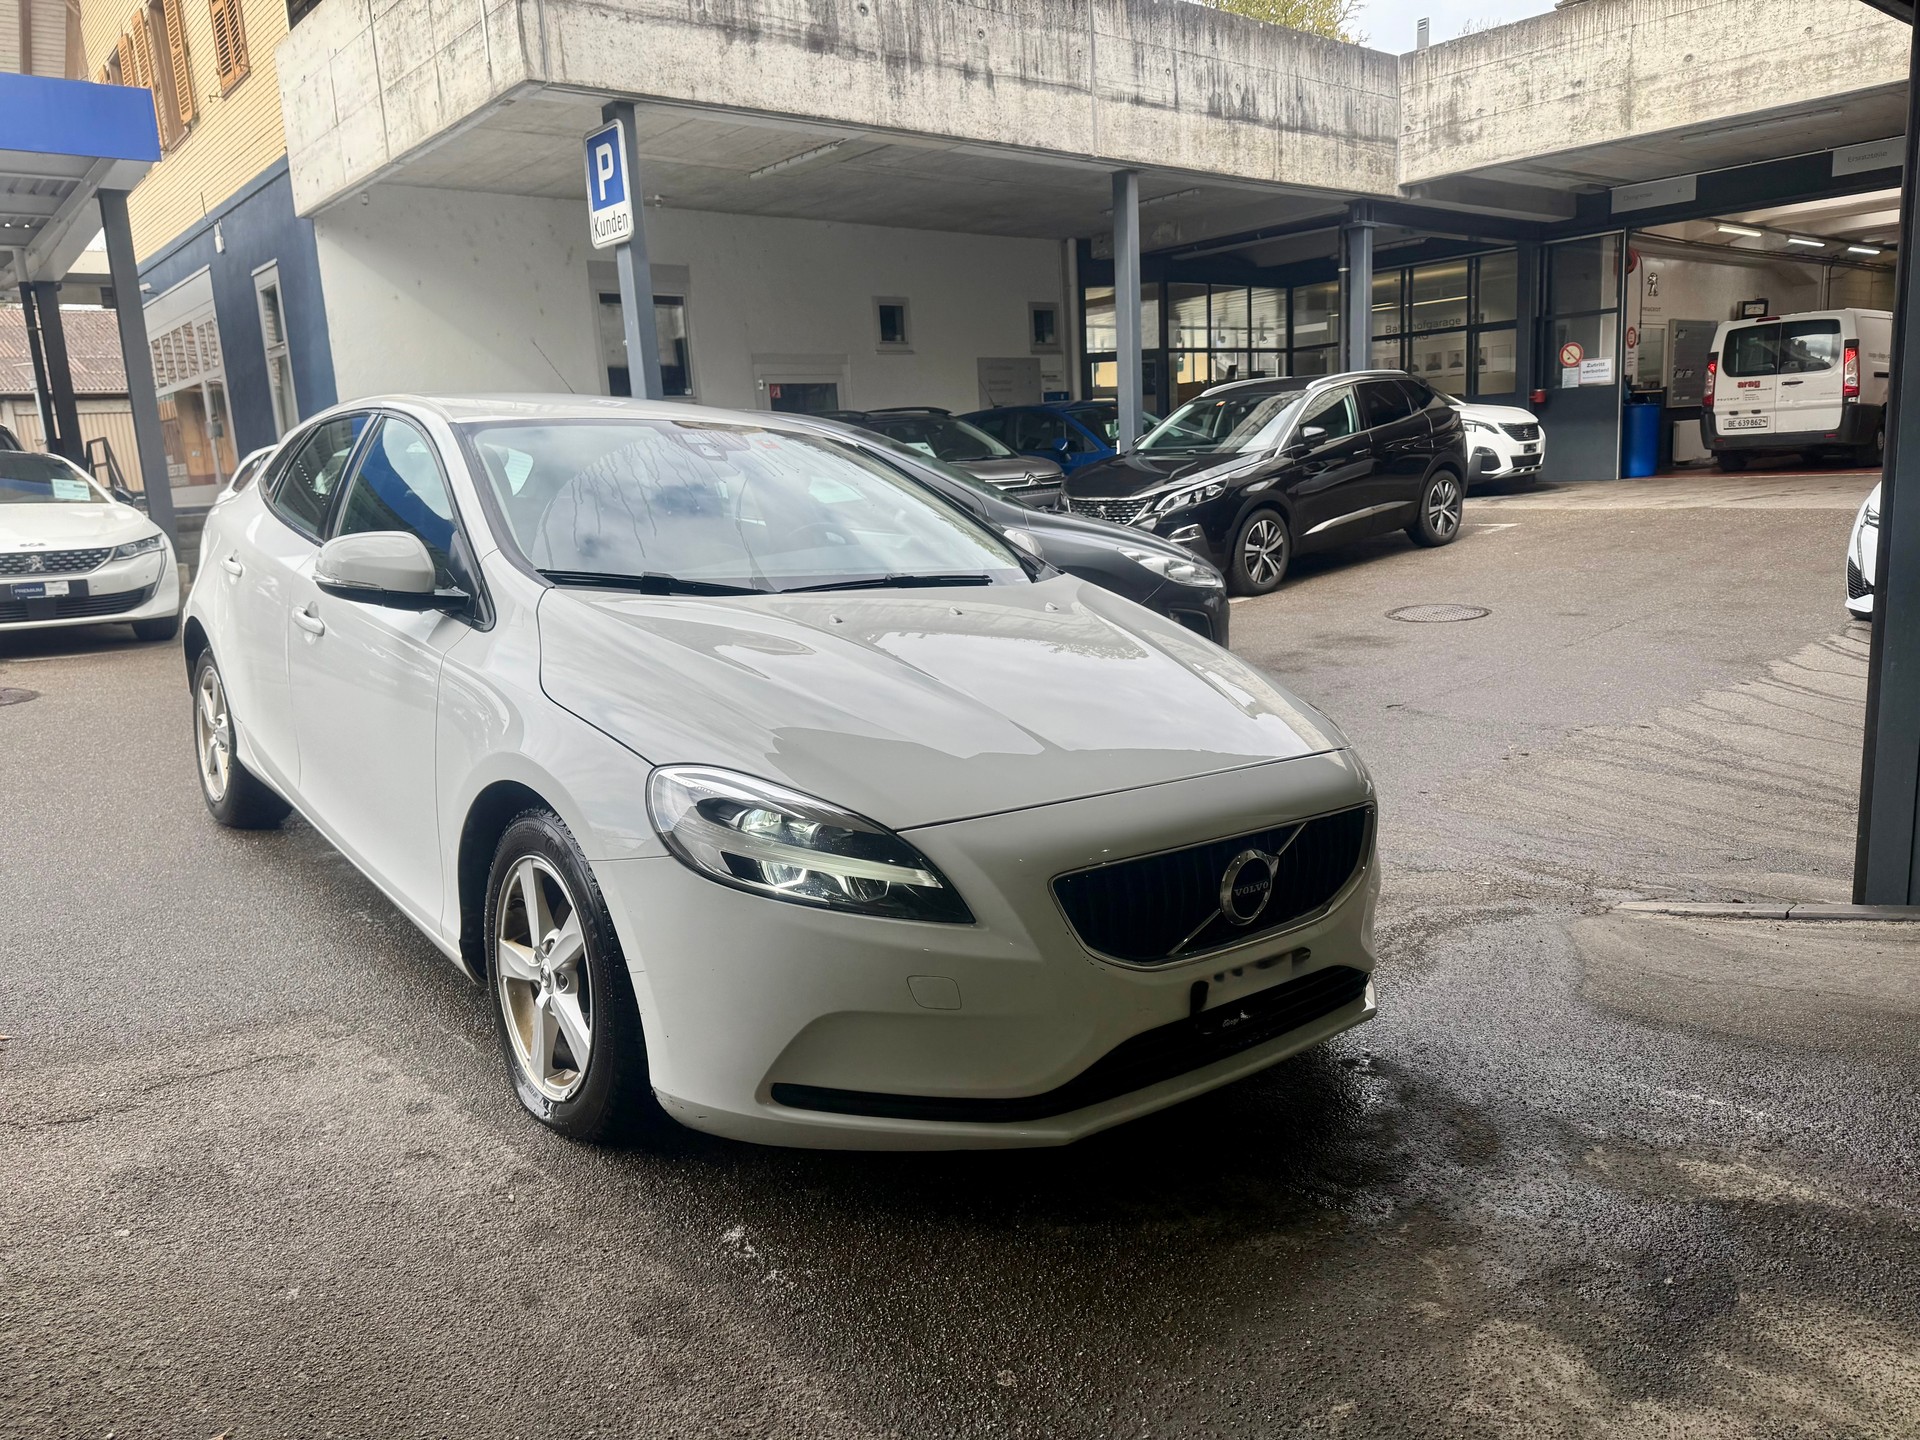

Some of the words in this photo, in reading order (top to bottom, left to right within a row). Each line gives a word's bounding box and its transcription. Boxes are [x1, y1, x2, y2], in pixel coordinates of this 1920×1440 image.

[595, 143, 614, 201] P
[594, 211, 628, 238] Kunden
[1385, 318, 1461, 333] Bahofgarage
[1737, 380, 1761, 388] arag
[1738, 419, 1762, 427] 639862
[1234, 881, 1269, 897] VOLVO
